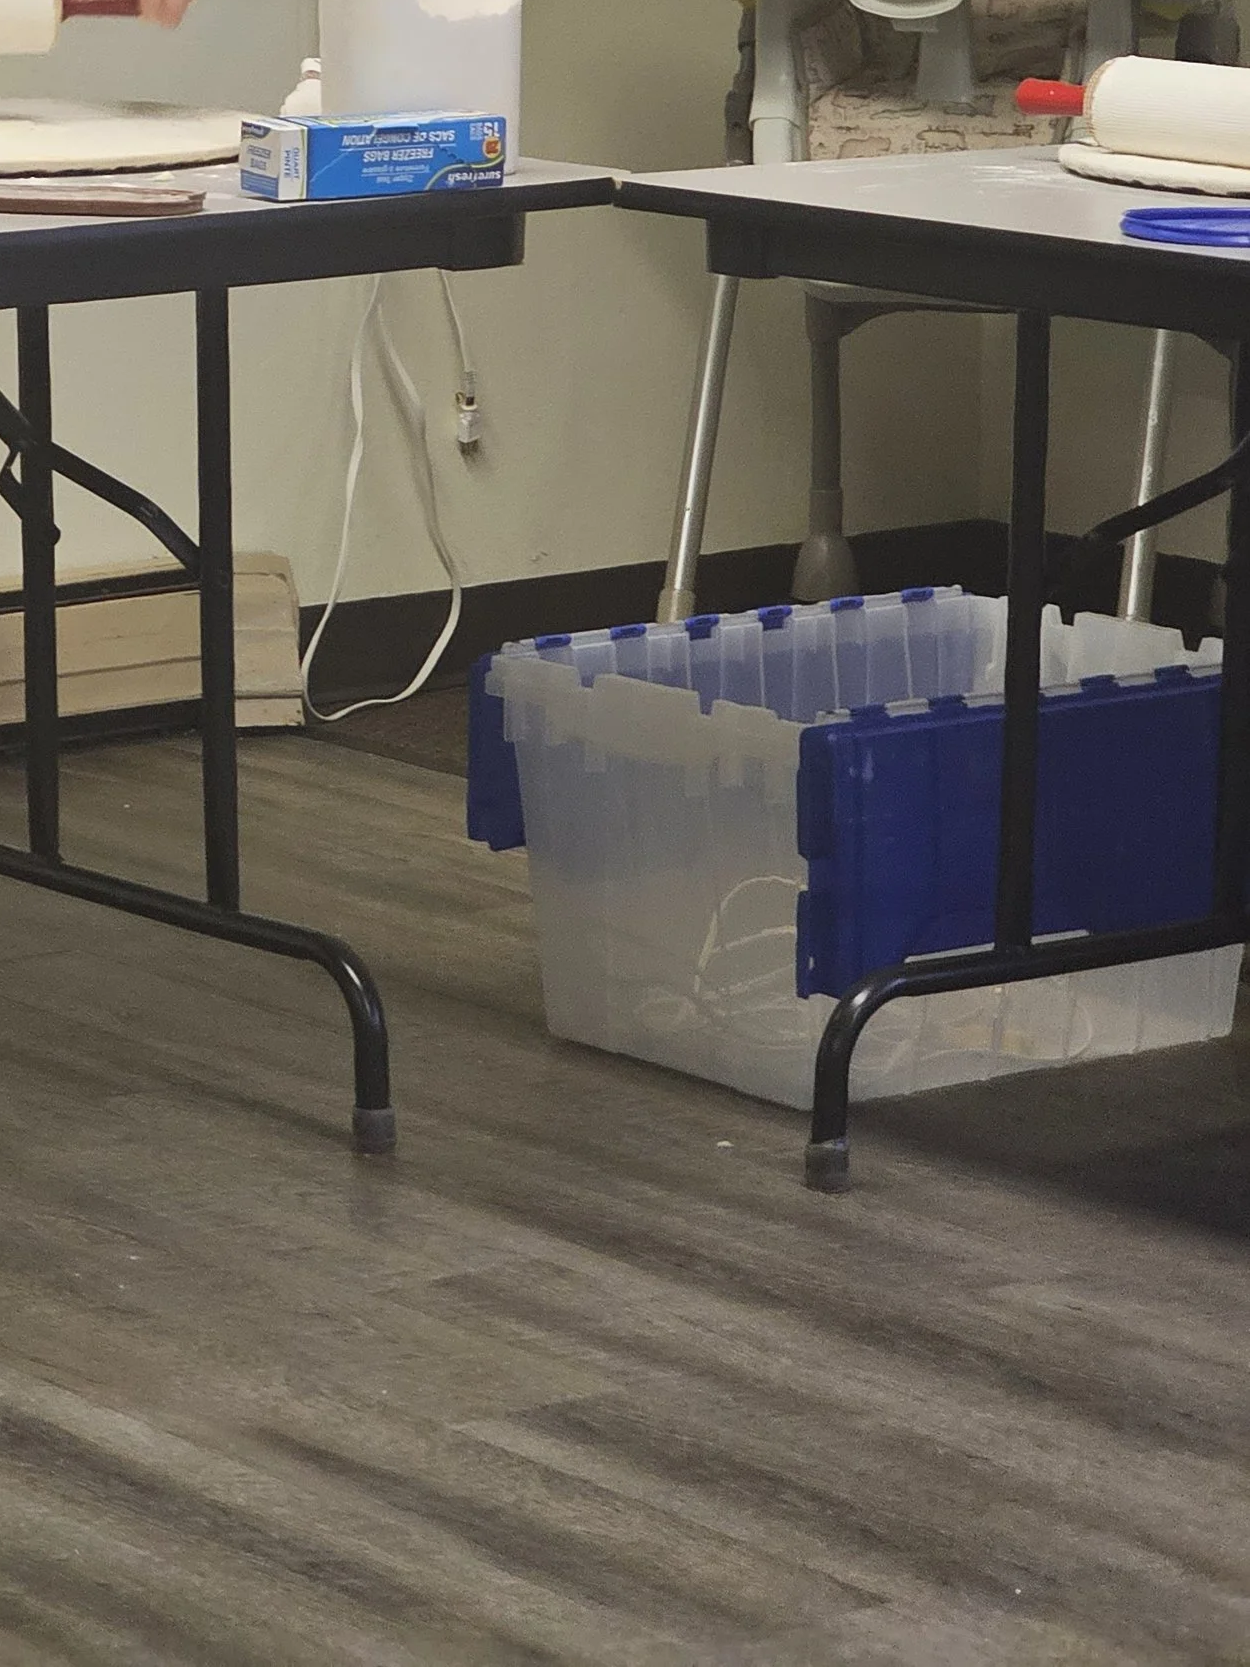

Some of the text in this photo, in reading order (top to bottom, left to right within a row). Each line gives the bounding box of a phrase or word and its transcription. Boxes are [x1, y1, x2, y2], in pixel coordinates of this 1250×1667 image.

[428, 130, 456, 142] SACS
[363, 147, 434, 163] FREEZER BAGS
